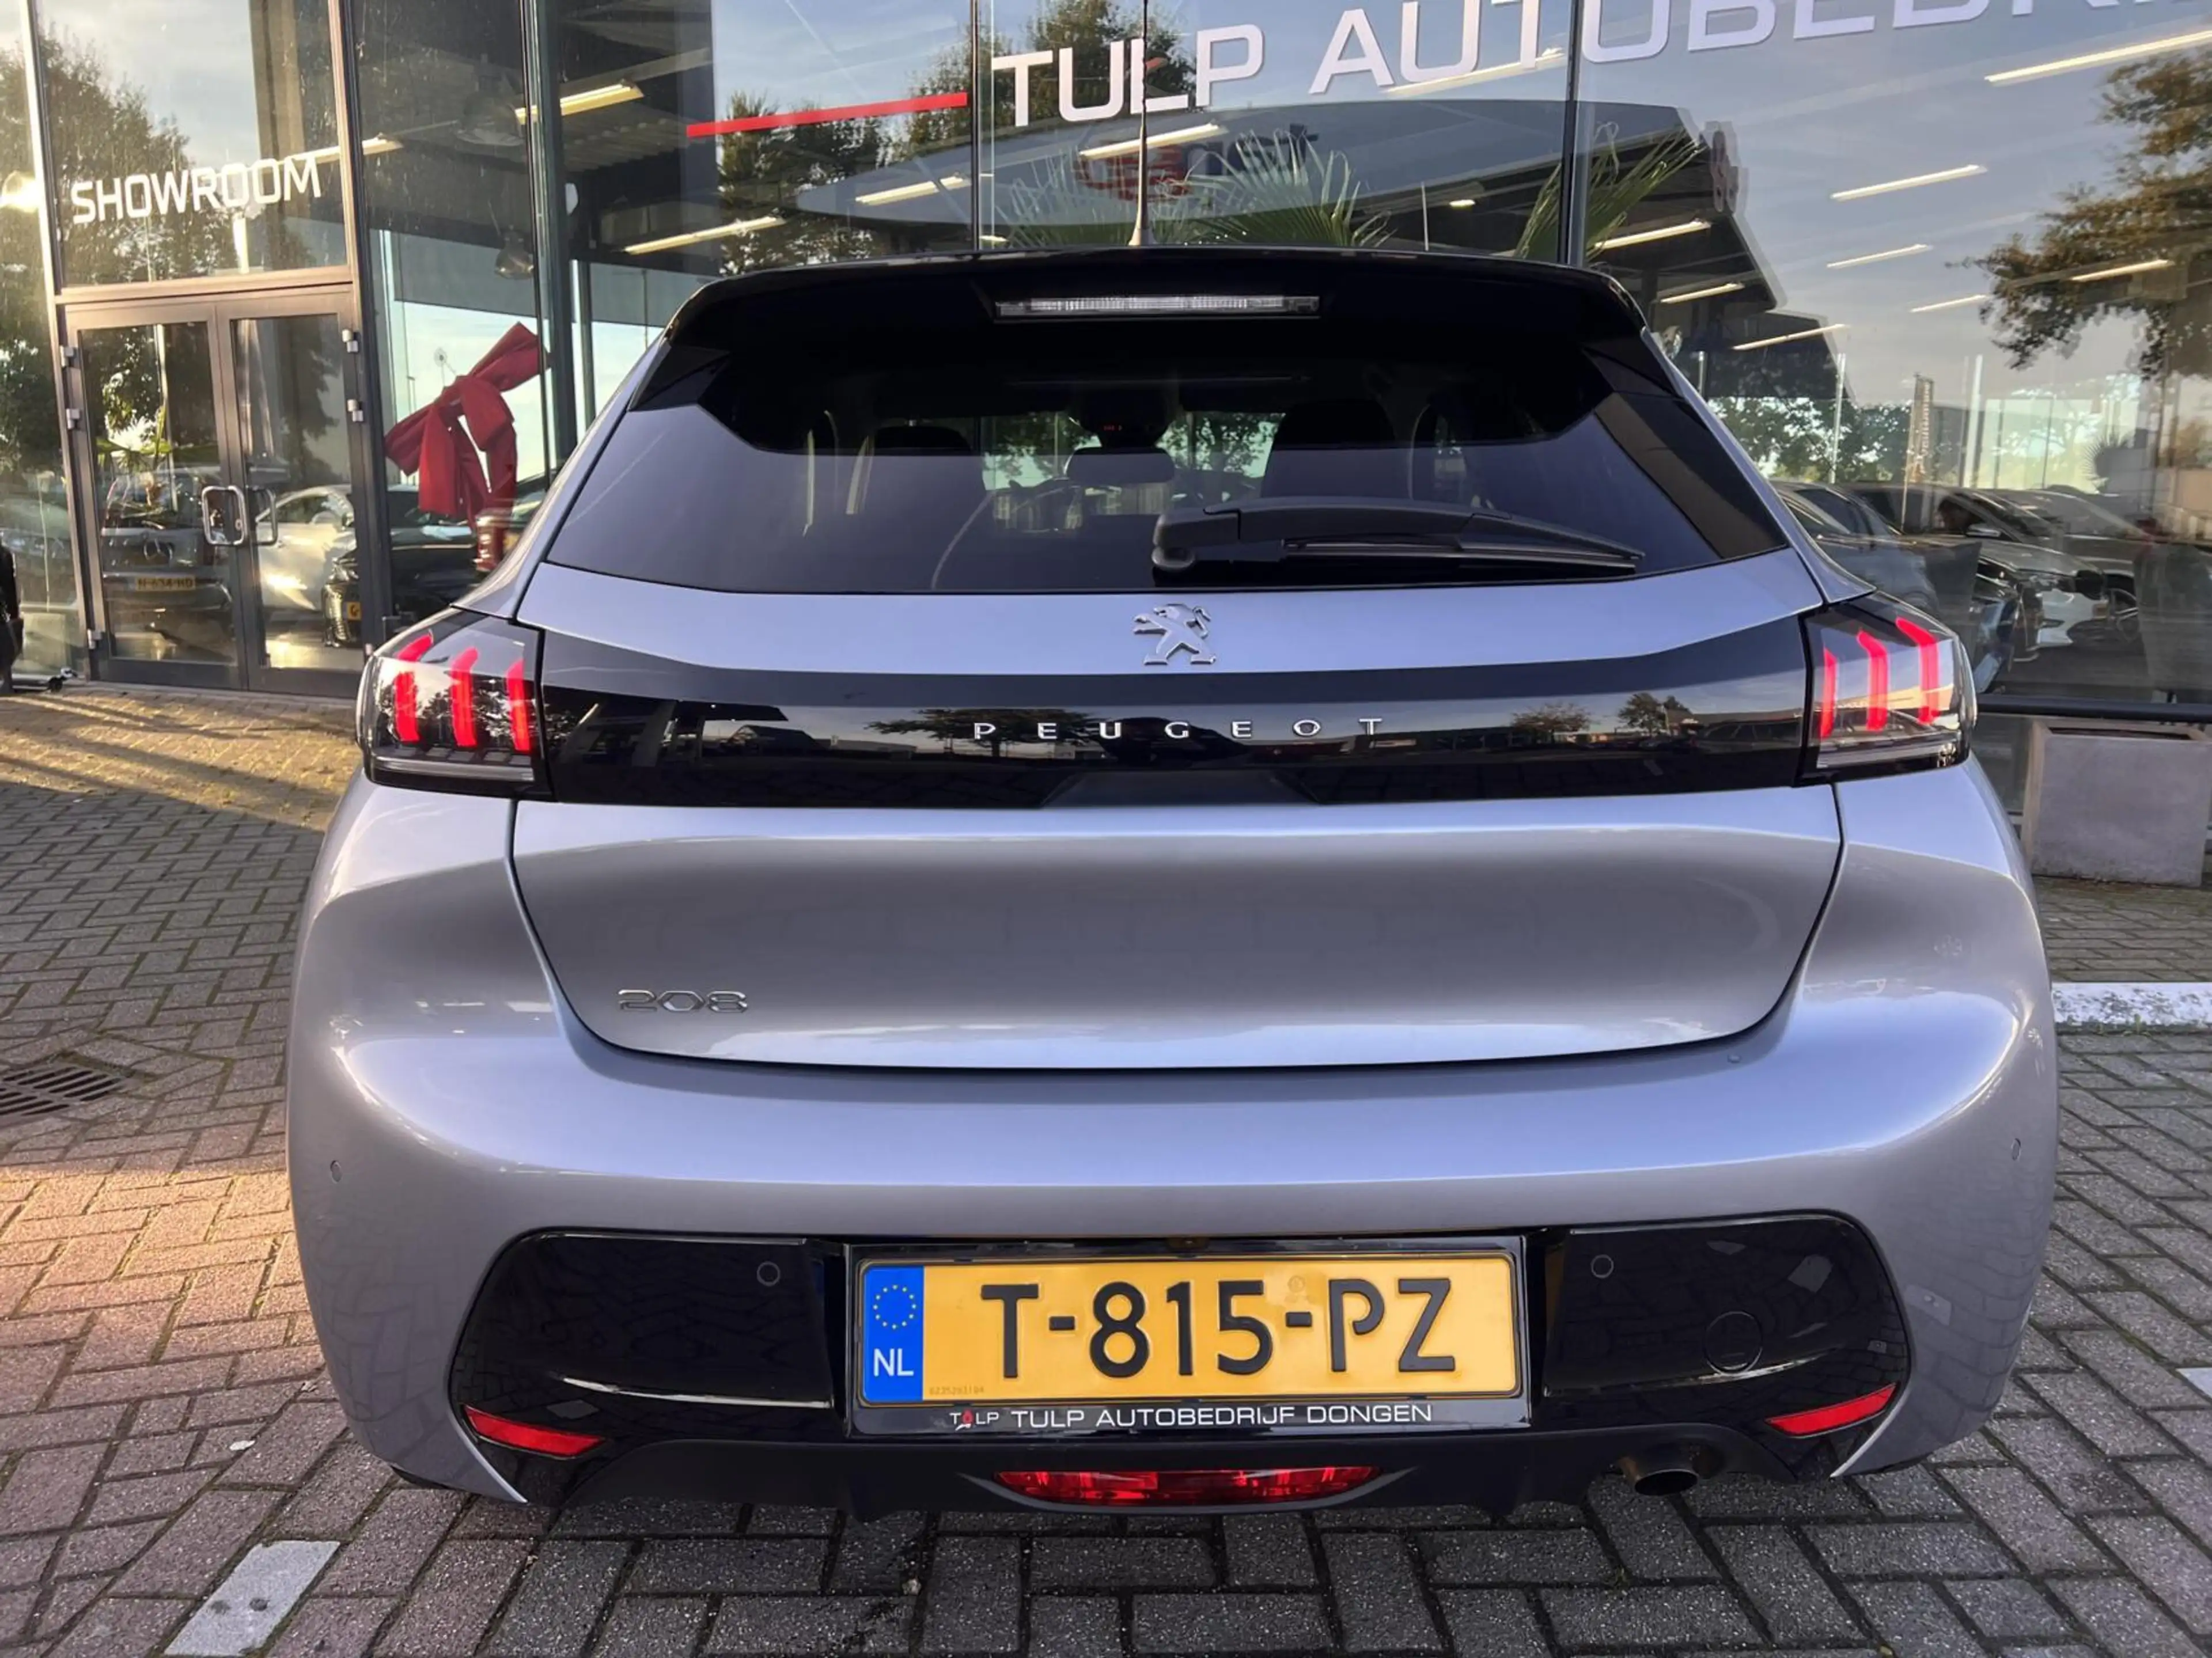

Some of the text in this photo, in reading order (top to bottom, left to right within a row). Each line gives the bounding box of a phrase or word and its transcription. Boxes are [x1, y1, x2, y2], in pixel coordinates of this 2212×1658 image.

[991, 24, 1264, 127] TULP
[70, 155, 322, 225] SHOWROOM
[974, 717, 1382, 740] PEUGEOT
[618, 989, 748, 1013] 208
[981, 1278, 1456, 1378] T-815-PZ
[873, 1348, 915, 1377] NL
[1010, 1409, 1085, 1428] TULP
[1096, 1406, 1295, 1426] AUTOBEDRIJF
[1306, 1404, 1432, 1424] DONGEN
